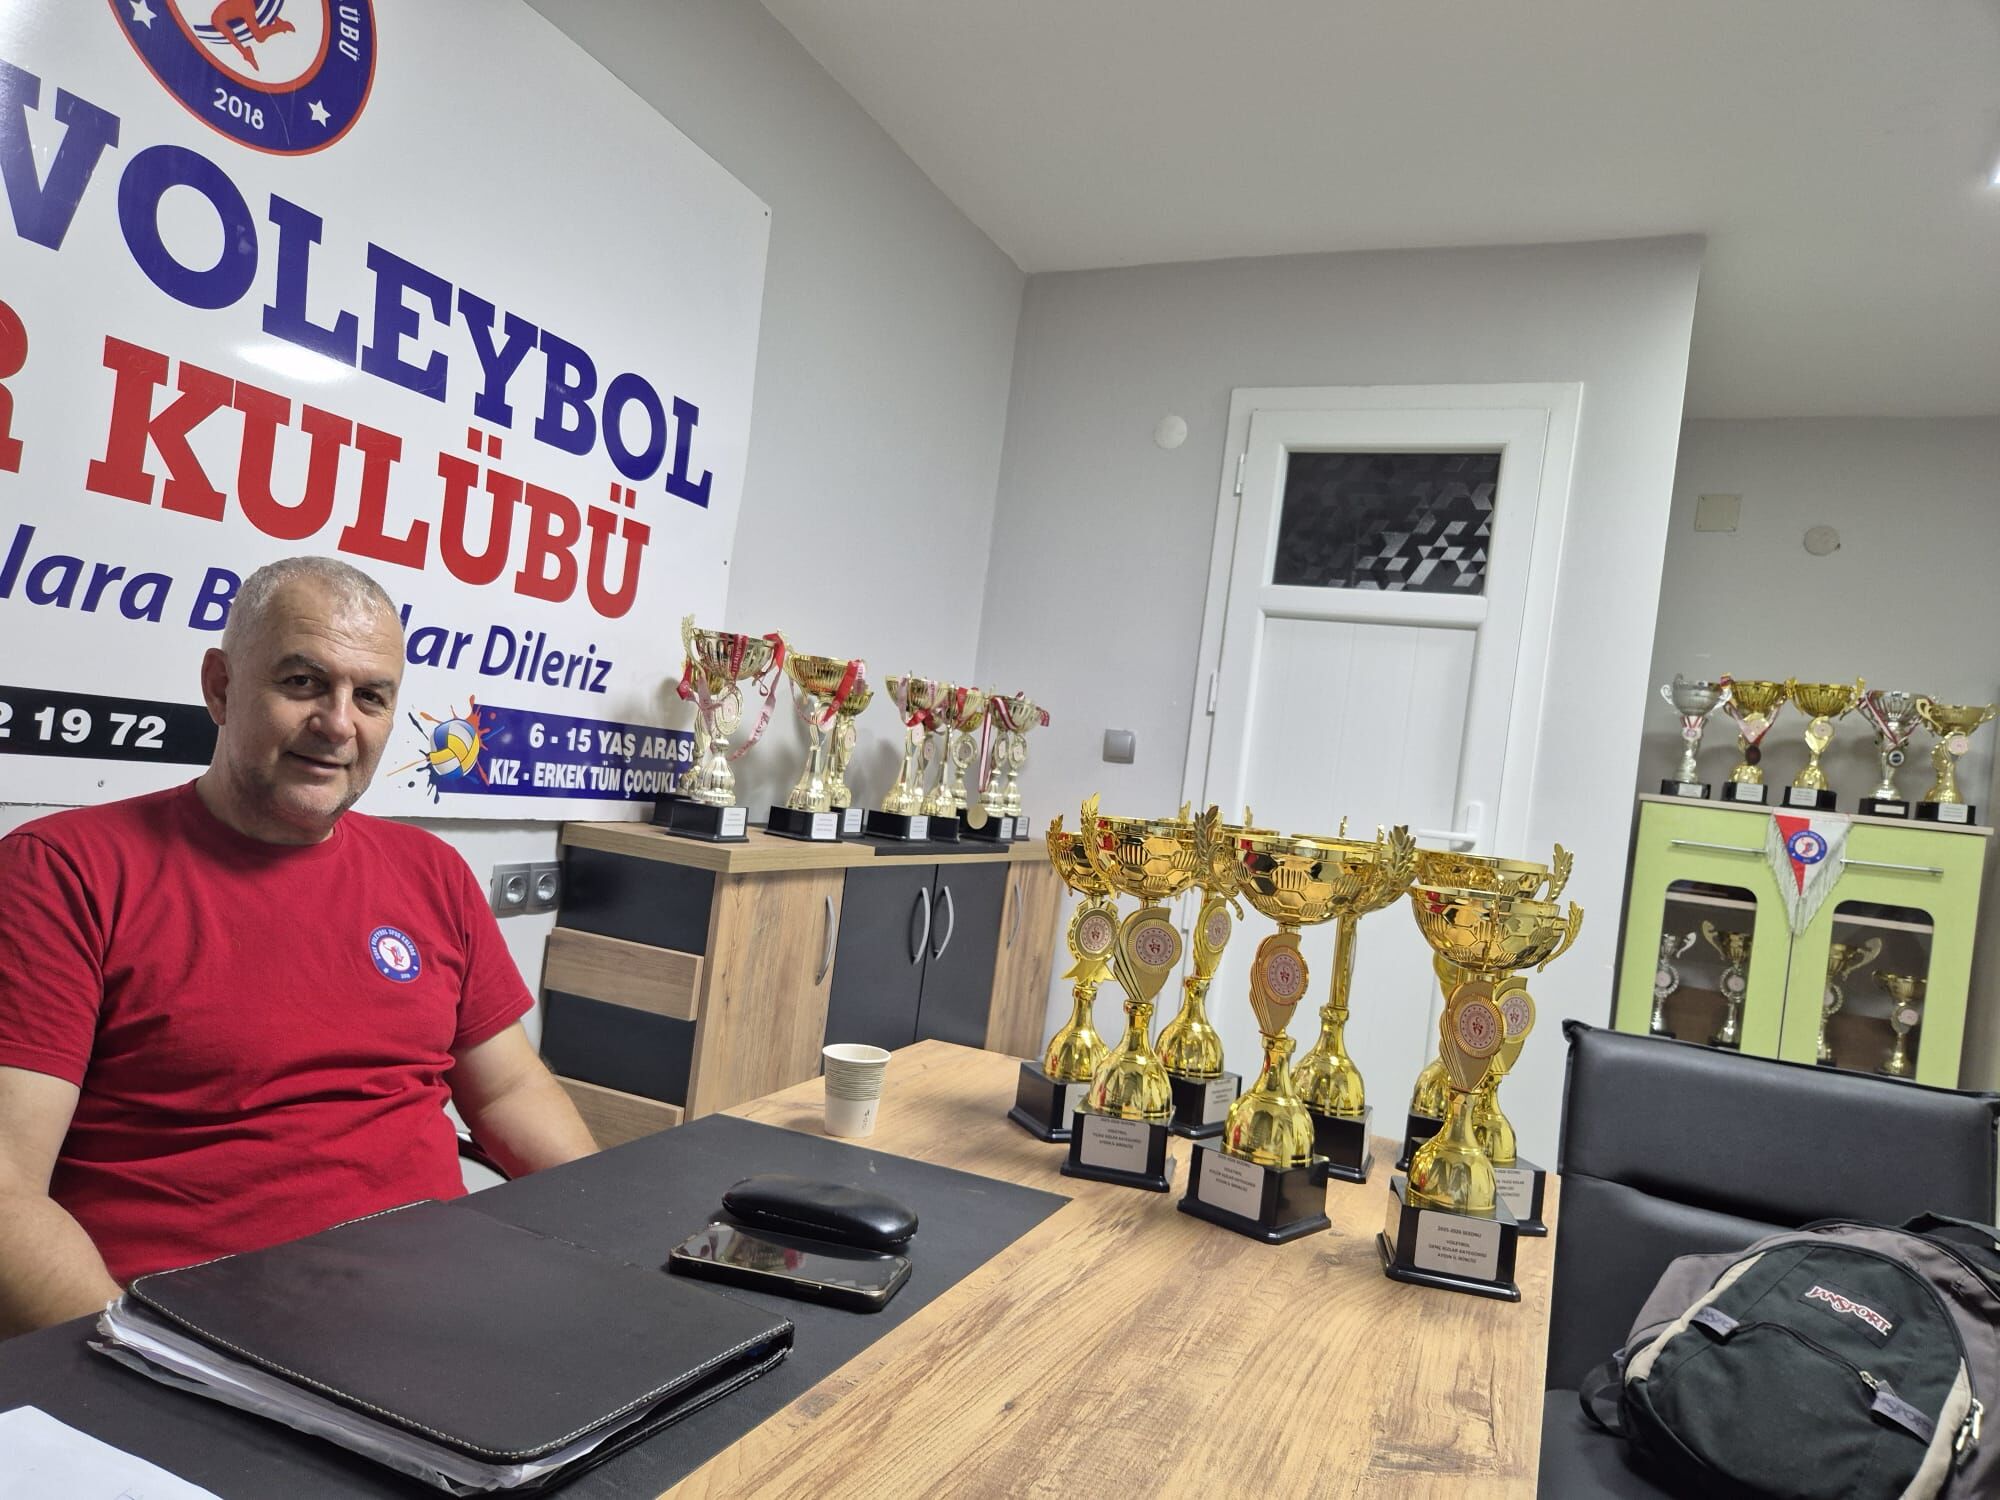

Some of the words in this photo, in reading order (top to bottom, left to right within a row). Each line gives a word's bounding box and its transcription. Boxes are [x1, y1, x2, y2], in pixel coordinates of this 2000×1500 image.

[338, 0, 361, 62] ÜBÜ
[213, 88, 265, 130] 2018
[0, 60, 713, 509] VOLEYBOL
[86, 335, 650, 619] KULÜBÜ
[0, 524, 174, 623] lara
[479, 625, 613, 694] Dileriz
[34, 706, 92, 744] 19
[109, 712, 167, 749] 72
[529, 722, 545, 749] 6
[566, 727, 592, 753] 15
[598, 730, 636, 763] YAŞ
[489, 758, 521, 786] KIZ
[533, 762, 587, 790] ERKEK
[590, 760, 621, 792] TÜM
[624, 768, 683, 799] ÇOCUKL
[1804, 1285, 1893, 1337] JANSPORT
